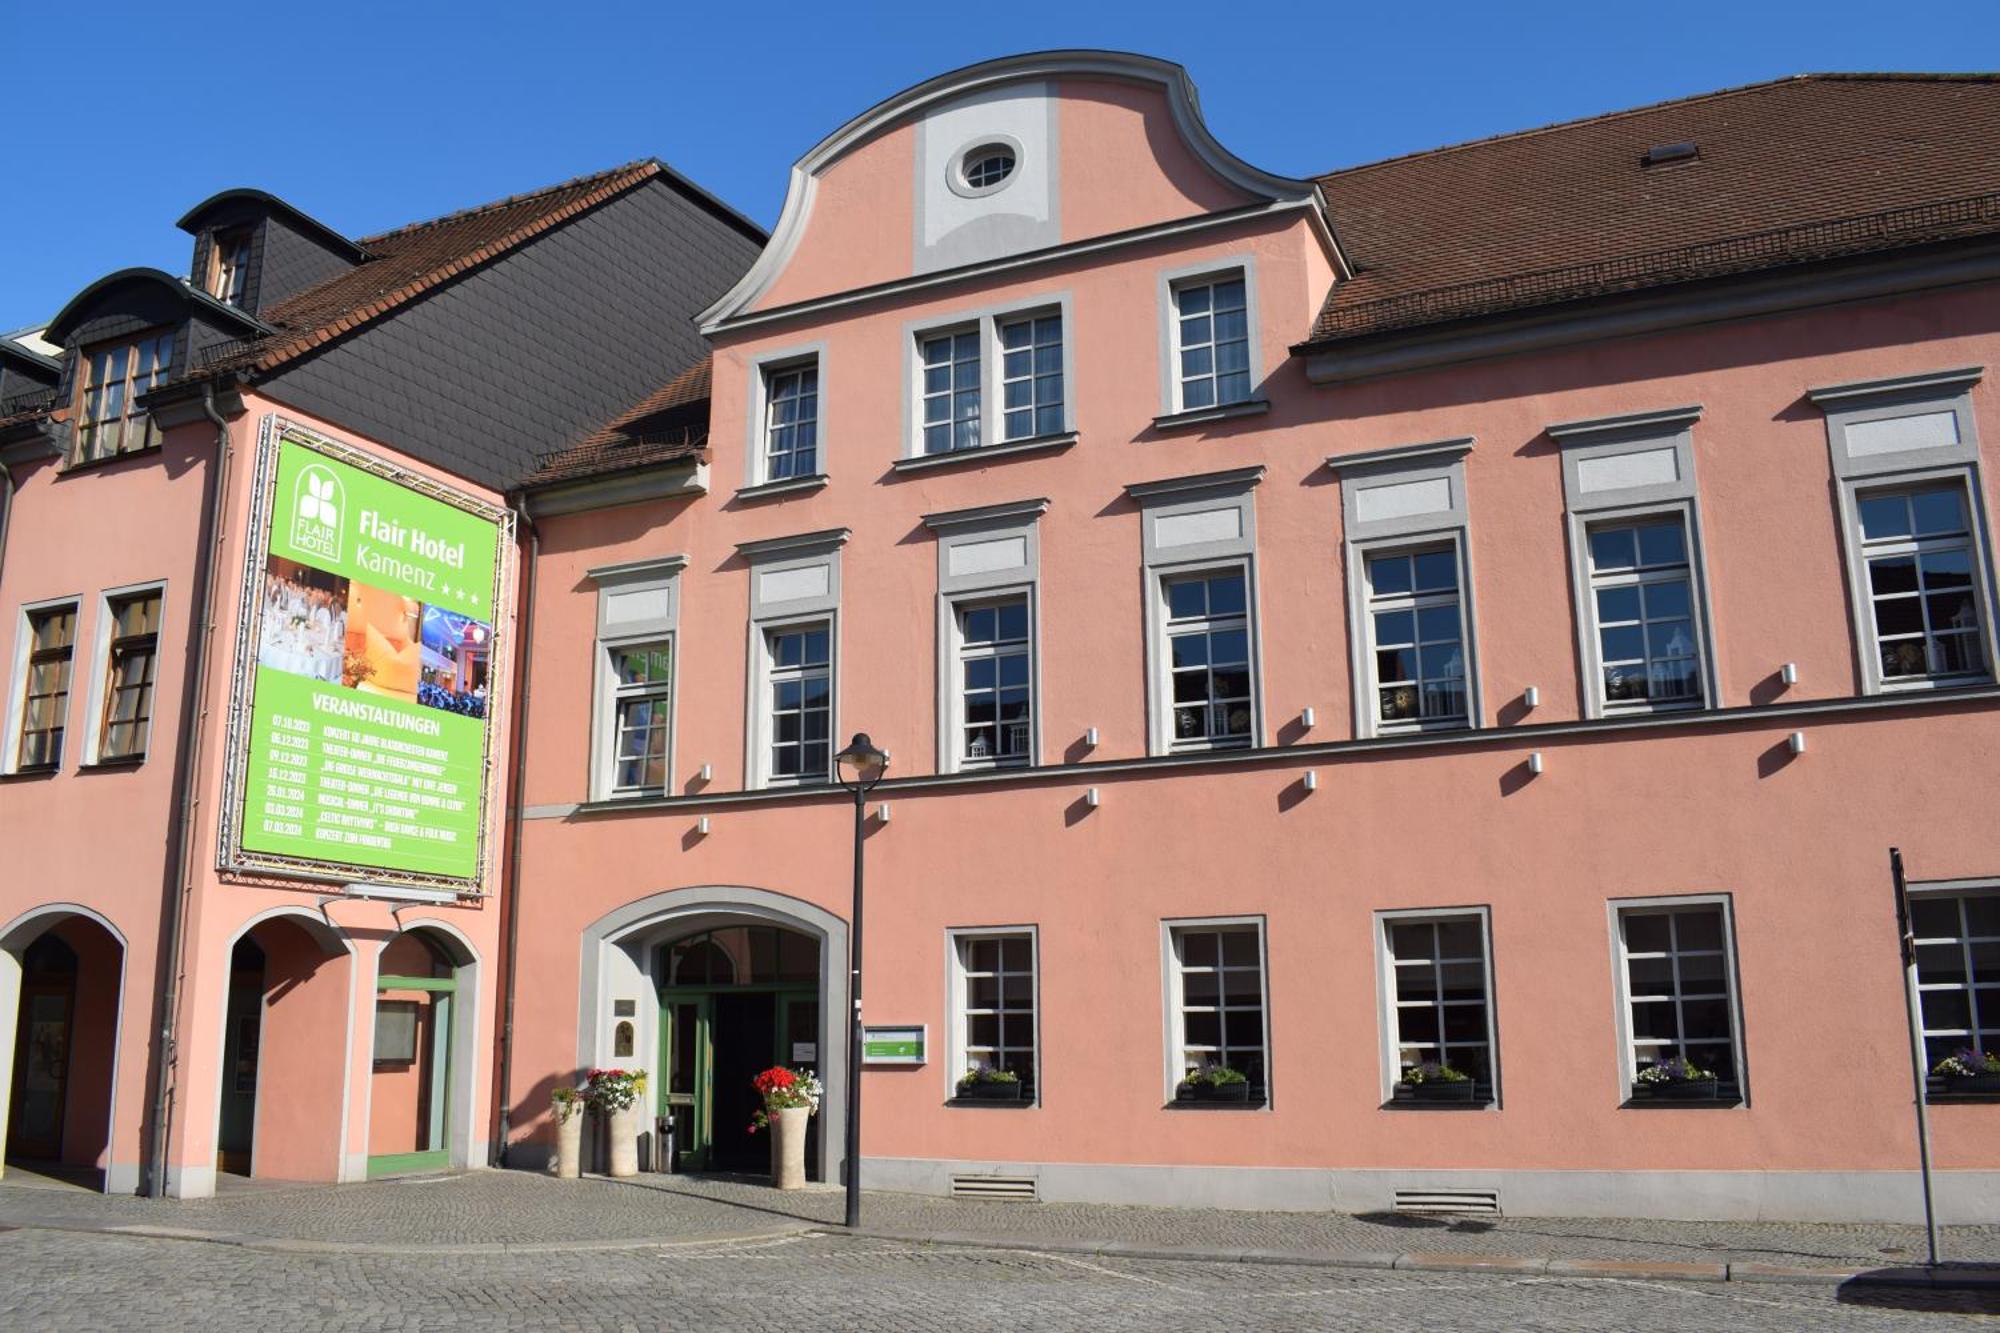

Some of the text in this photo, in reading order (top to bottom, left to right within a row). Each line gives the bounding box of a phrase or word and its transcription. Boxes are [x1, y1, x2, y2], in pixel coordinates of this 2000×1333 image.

[296, 533, 336, 555] HOTEL
[297, 518, 334, 540] FLAIR
[360, 510, 465, 569] Flair Hotel
[356, 544, 436, 591] Kamenz
[312, 692, 441, 737] VERANSTALTUNGEN
